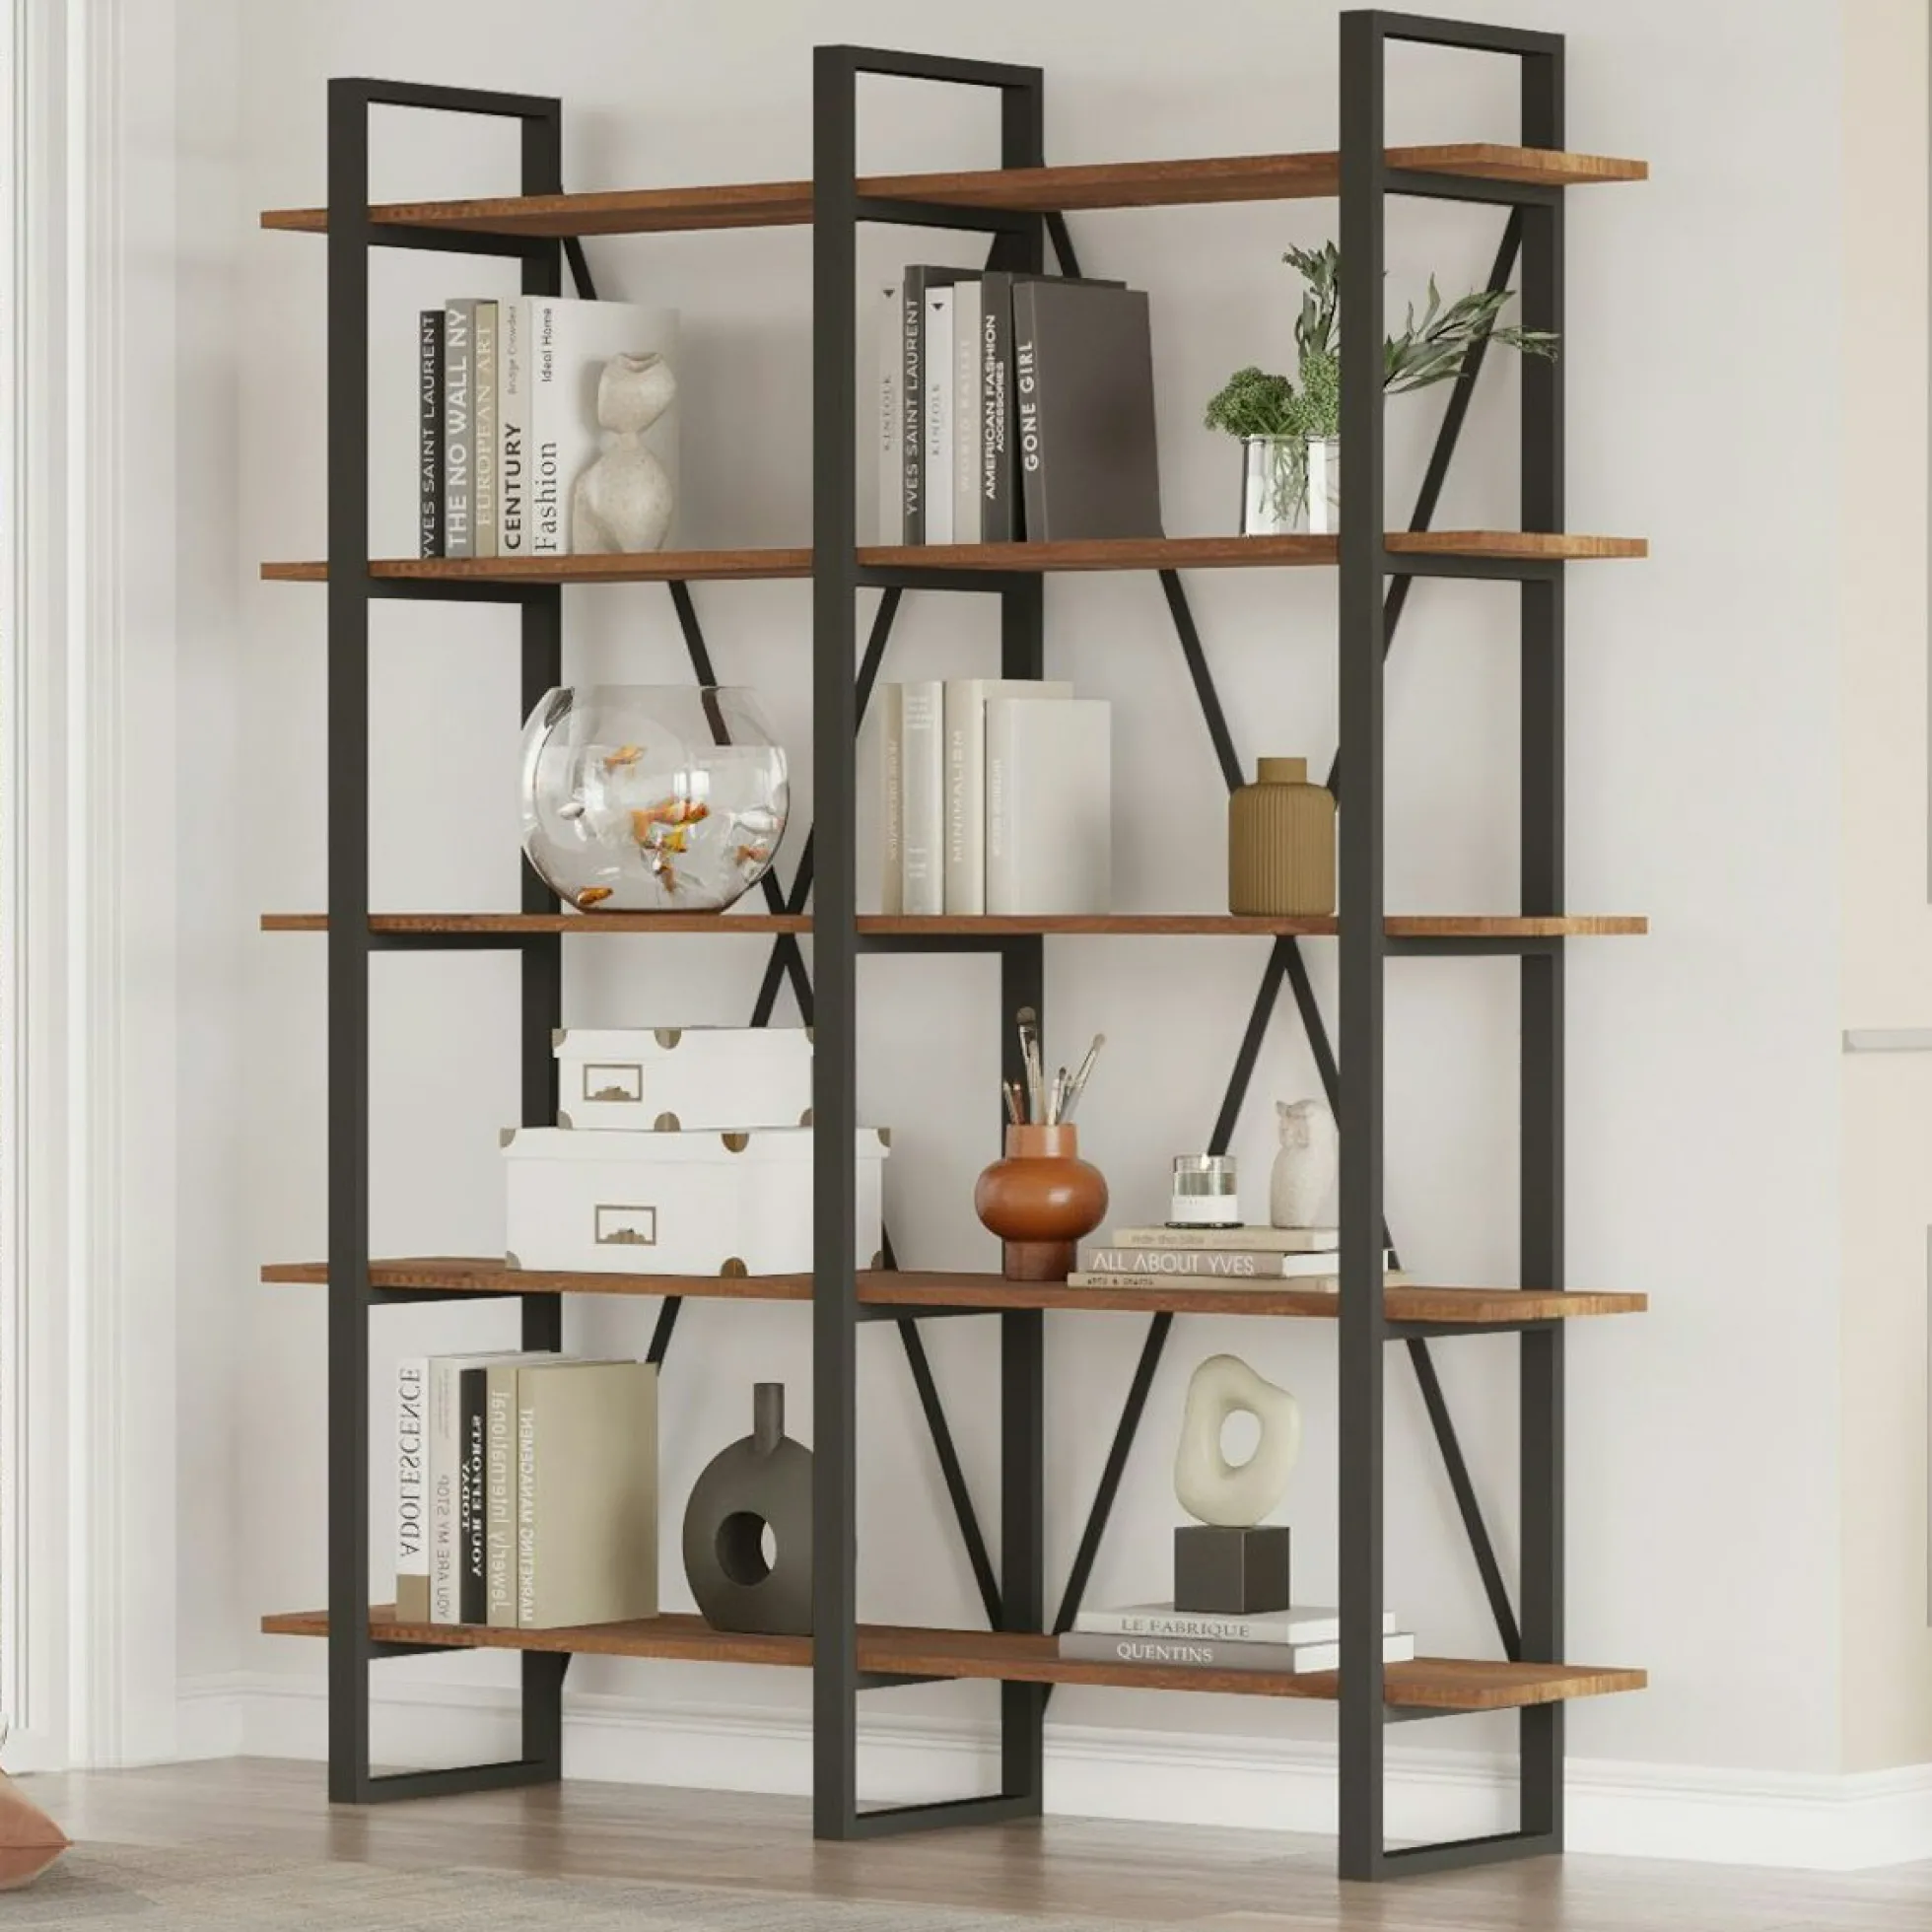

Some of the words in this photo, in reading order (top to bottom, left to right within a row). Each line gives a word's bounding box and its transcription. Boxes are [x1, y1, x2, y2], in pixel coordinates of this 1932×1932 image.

[448, 309, 467, 346] NY
[477, 326, 491, 372] ART
[541, 309, 552, 345] Home
[906, 300, 919, 391] LAURENT
[986, 314, 997, 397] FASHION
[423, 315, 435, 418] LAURENT
[448, 356, 467, 434] WALL
[541, 351, 552, 382] Ideal
[1018, 341, 1034, 393] GIRL
[477, 384, 491, 525] EUROPEAN
[906, 397, 919, 457] SAINT
[986, 401, 997, 500] AMERICAN
[1021, 402, 1039, 471] GONE
[423, 429, 435, 493] SAINT
[448, 445, 467, 486] NO
[505, 423, 521, 549] CENTURY
[906, 464, 919, 515] YVES
[448, 495, 467, 548] THE
[534, 443, 557, 551] Fashion
[423, 501, 435, 558] YVES
[1092, 1252, 1128, 1272] ALL
[1134, 1253, 1200, 1274] ABOUT
[1208, 1254, 1255, 1274] YVES
[1116, 1642, 1212, 1663] QUENTINS
[1122, 1619, 1143, 1631] LE
[1150, 1620, 1250, 1638] FABRIQUE
